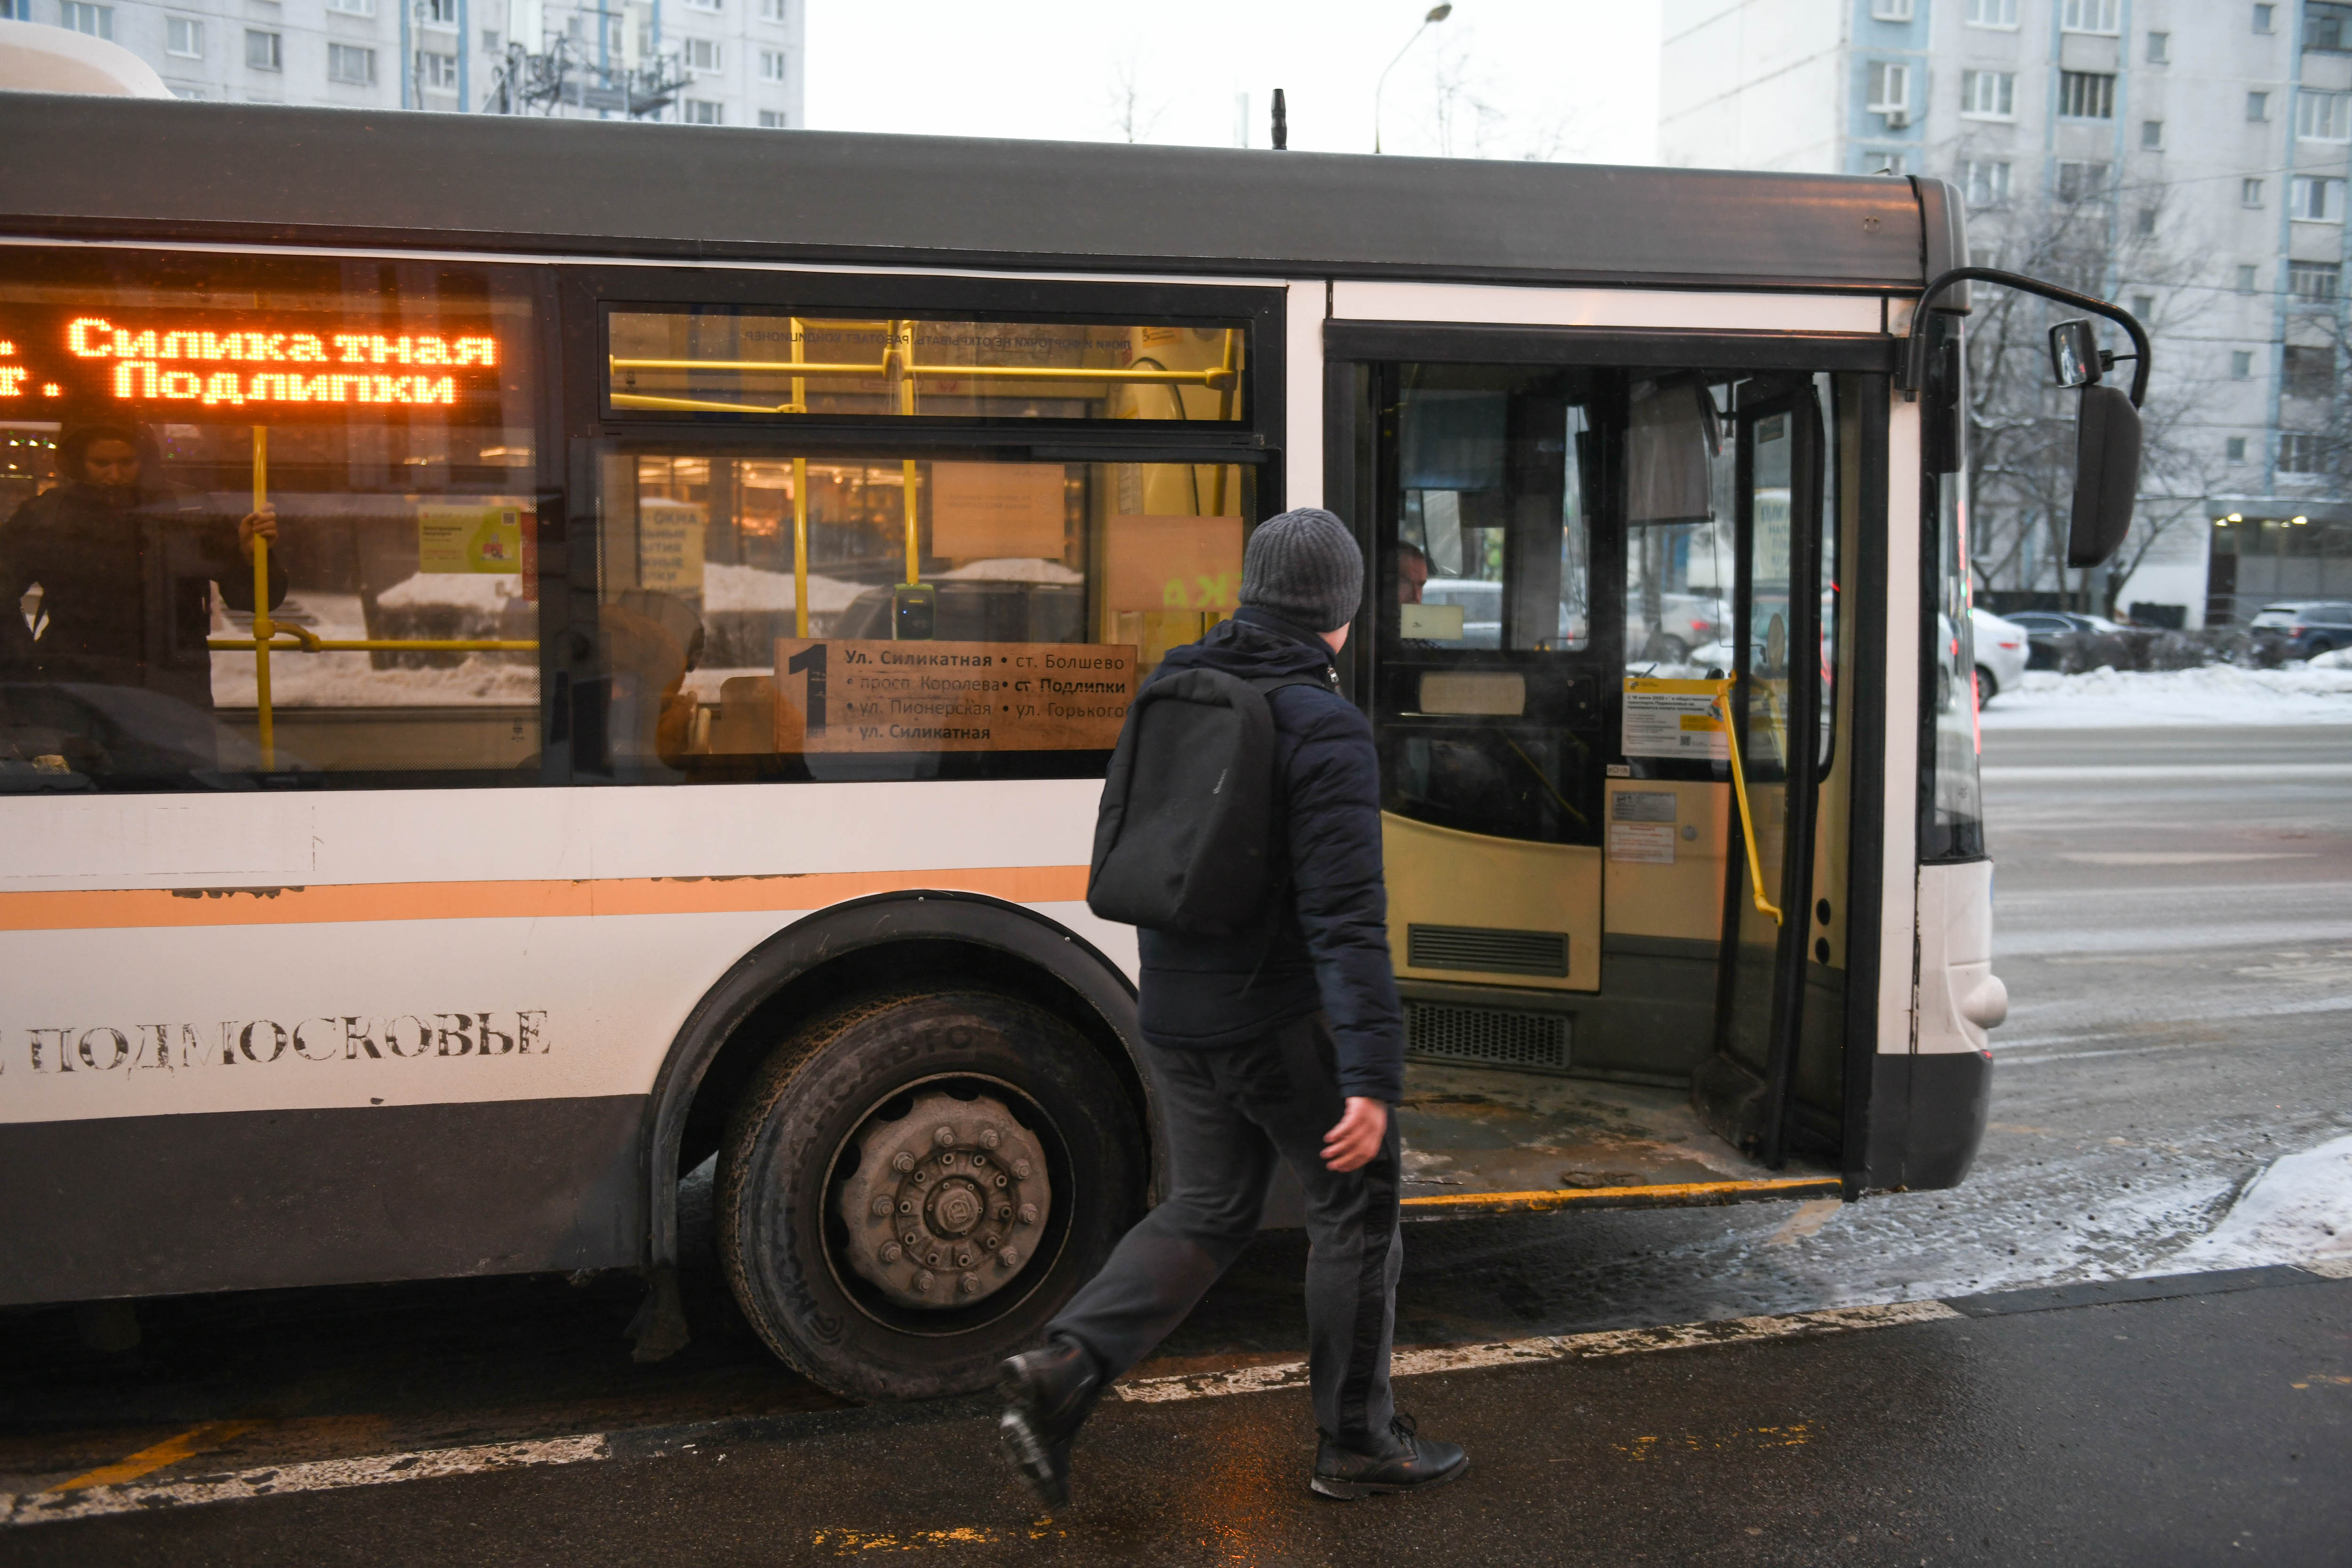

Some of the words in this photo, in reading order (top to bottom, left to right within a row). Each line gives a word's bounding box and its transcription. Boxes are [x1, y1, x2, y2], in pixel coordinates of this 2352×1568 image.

[70, 318, 494, 366] Силикатная
[115, 360, 454, 404] Подлипки
[789, 644, 827, 739] 1
[845, 650, 873, 665] Ул.
[881, 650, 993, 667] Силикатная
[1016, 657, 1038, 668] ст.
[1046, 654, 1124, 669] Болшево
[921, 676, 1000, 692] Королева
[1040, 678, 1125, 695] Подлипки
[859, 701, 884, 716] ул.
[891, 700, 991, 718] Пионерская
[1016, 706, 1041, 719] ул.
[1048, 702, 1124, 720] Горького
[859, 725, 884, 740] ул.
[890, 724, 991, 740] Силикатная
[24, 1010, 551, 1081] ПОДМОСКОВЬЕ
